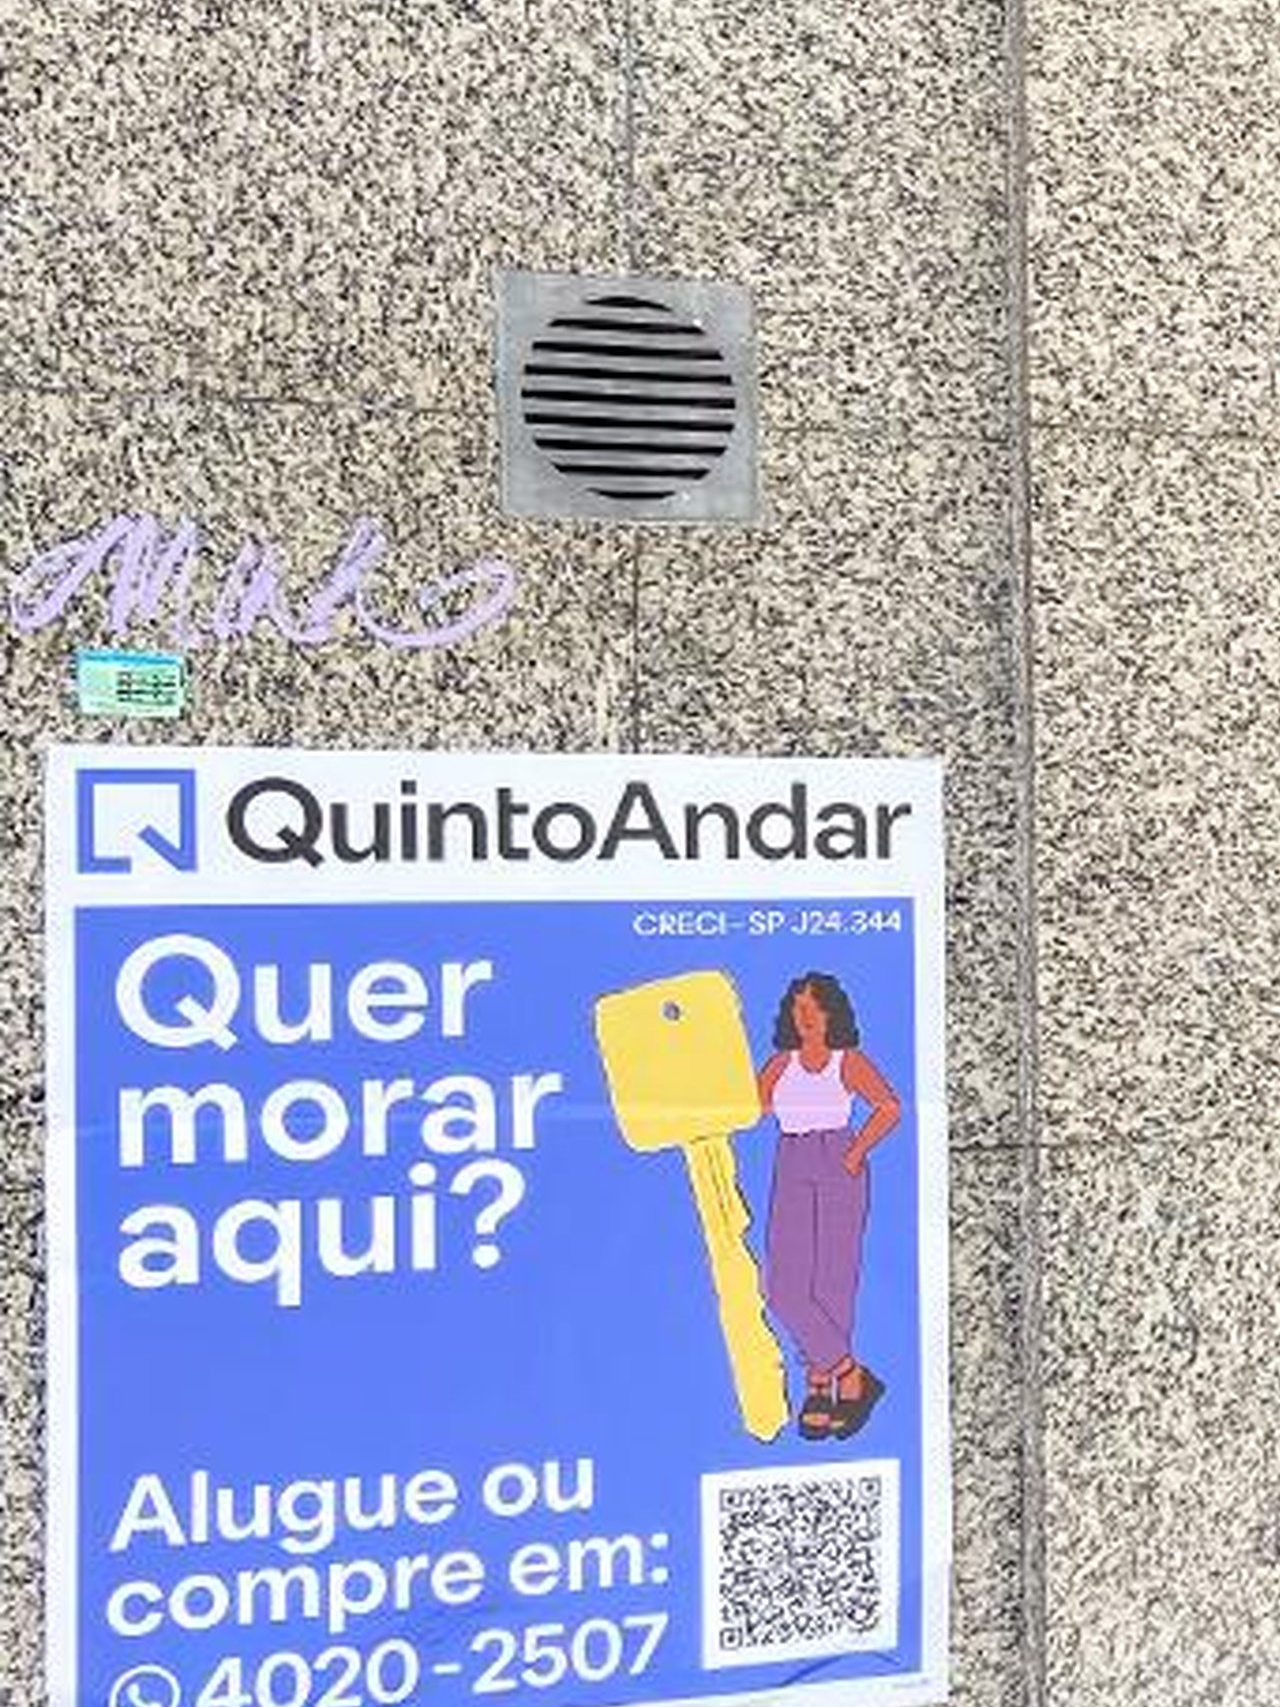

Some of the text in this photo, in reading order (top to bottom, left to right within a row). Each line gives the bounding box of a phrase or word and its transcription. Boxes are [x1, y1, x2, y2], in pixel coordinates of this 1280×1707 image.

[226, 777, 912, 868] QuintoAndar
[791, 910, 901, 934] J24.344
[115, 933, 492, 1051] Quer
[119, 1072, 562, 1167] morar
[119, 1158, 525, 1306] aqui?
[110, 1458, 594, 1554] Alugue ou
[106, 1533, 668, 1636] compre em:
